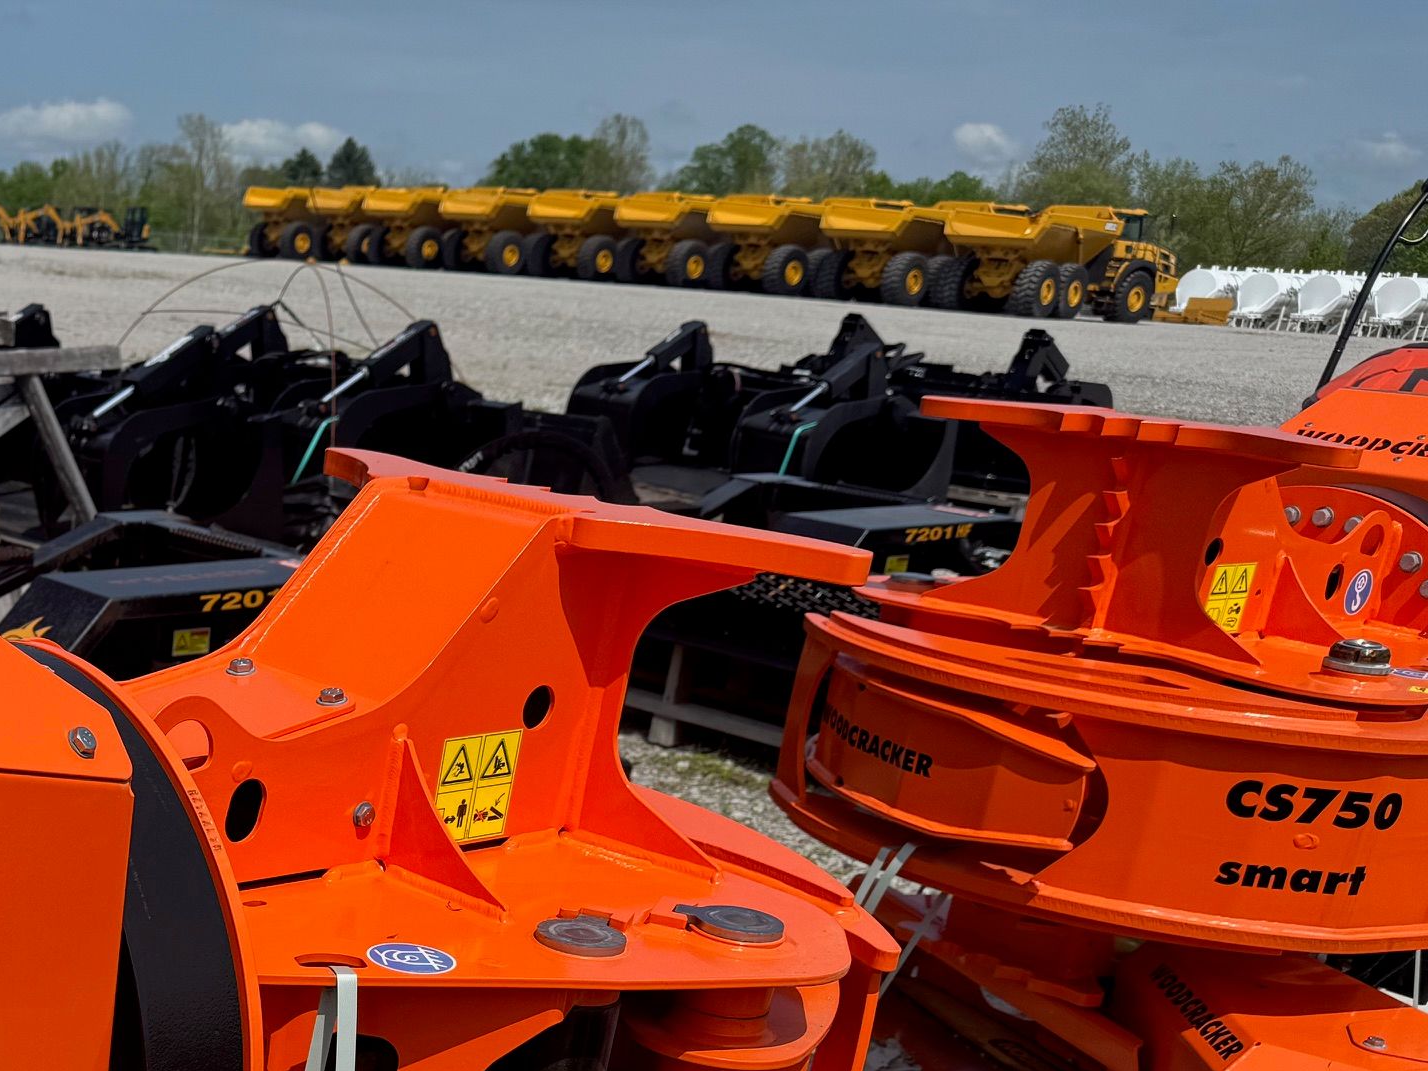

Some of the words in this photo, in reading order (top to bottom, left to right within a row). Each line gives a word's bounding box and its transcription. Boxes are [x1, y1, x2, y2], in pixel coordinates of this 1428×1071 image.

[905, 526, 953, 544] 7201
[1226, 780, 1403, 831] CS750
[1214, 860, 1367, 896] smart
